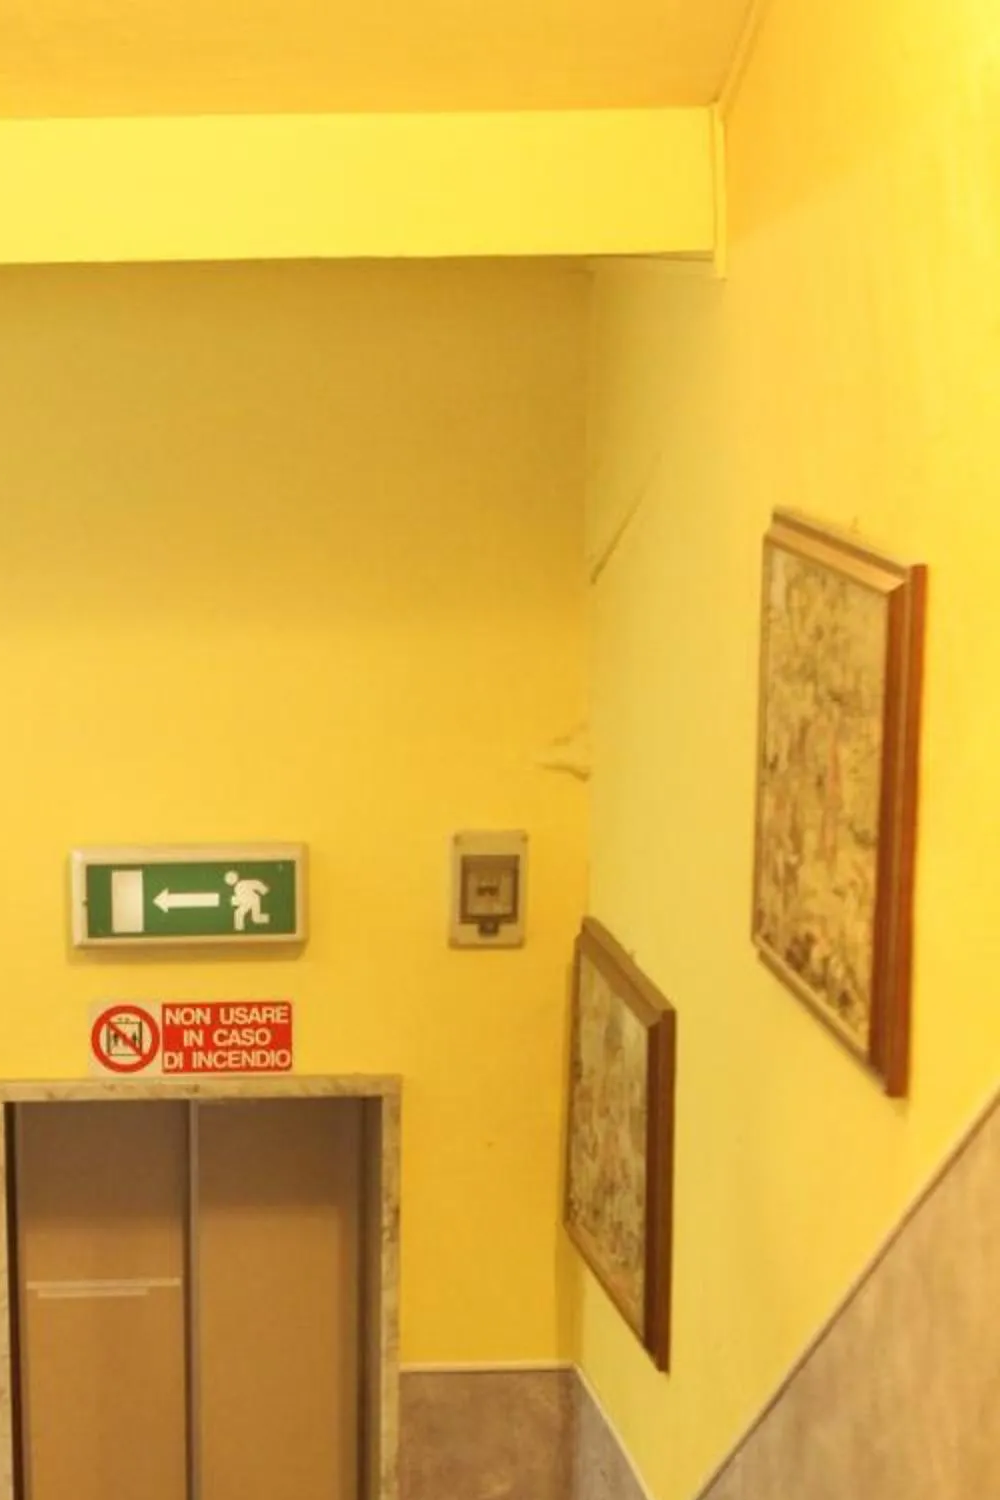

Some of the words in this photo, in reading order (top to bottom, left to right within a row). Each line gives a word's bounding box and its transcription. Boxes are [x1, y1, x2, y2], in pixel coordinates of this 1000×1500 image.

[165, 1007, 211, 1025] NON
[219, 1006, 289, 1025] USARE
[183, 1029, 203, 1047] IN
[212, 1028, 272, 1047] CASO
[164, 1052, 184, 1069] DI
[192, 1049, 291, 1069] INCENDIO
